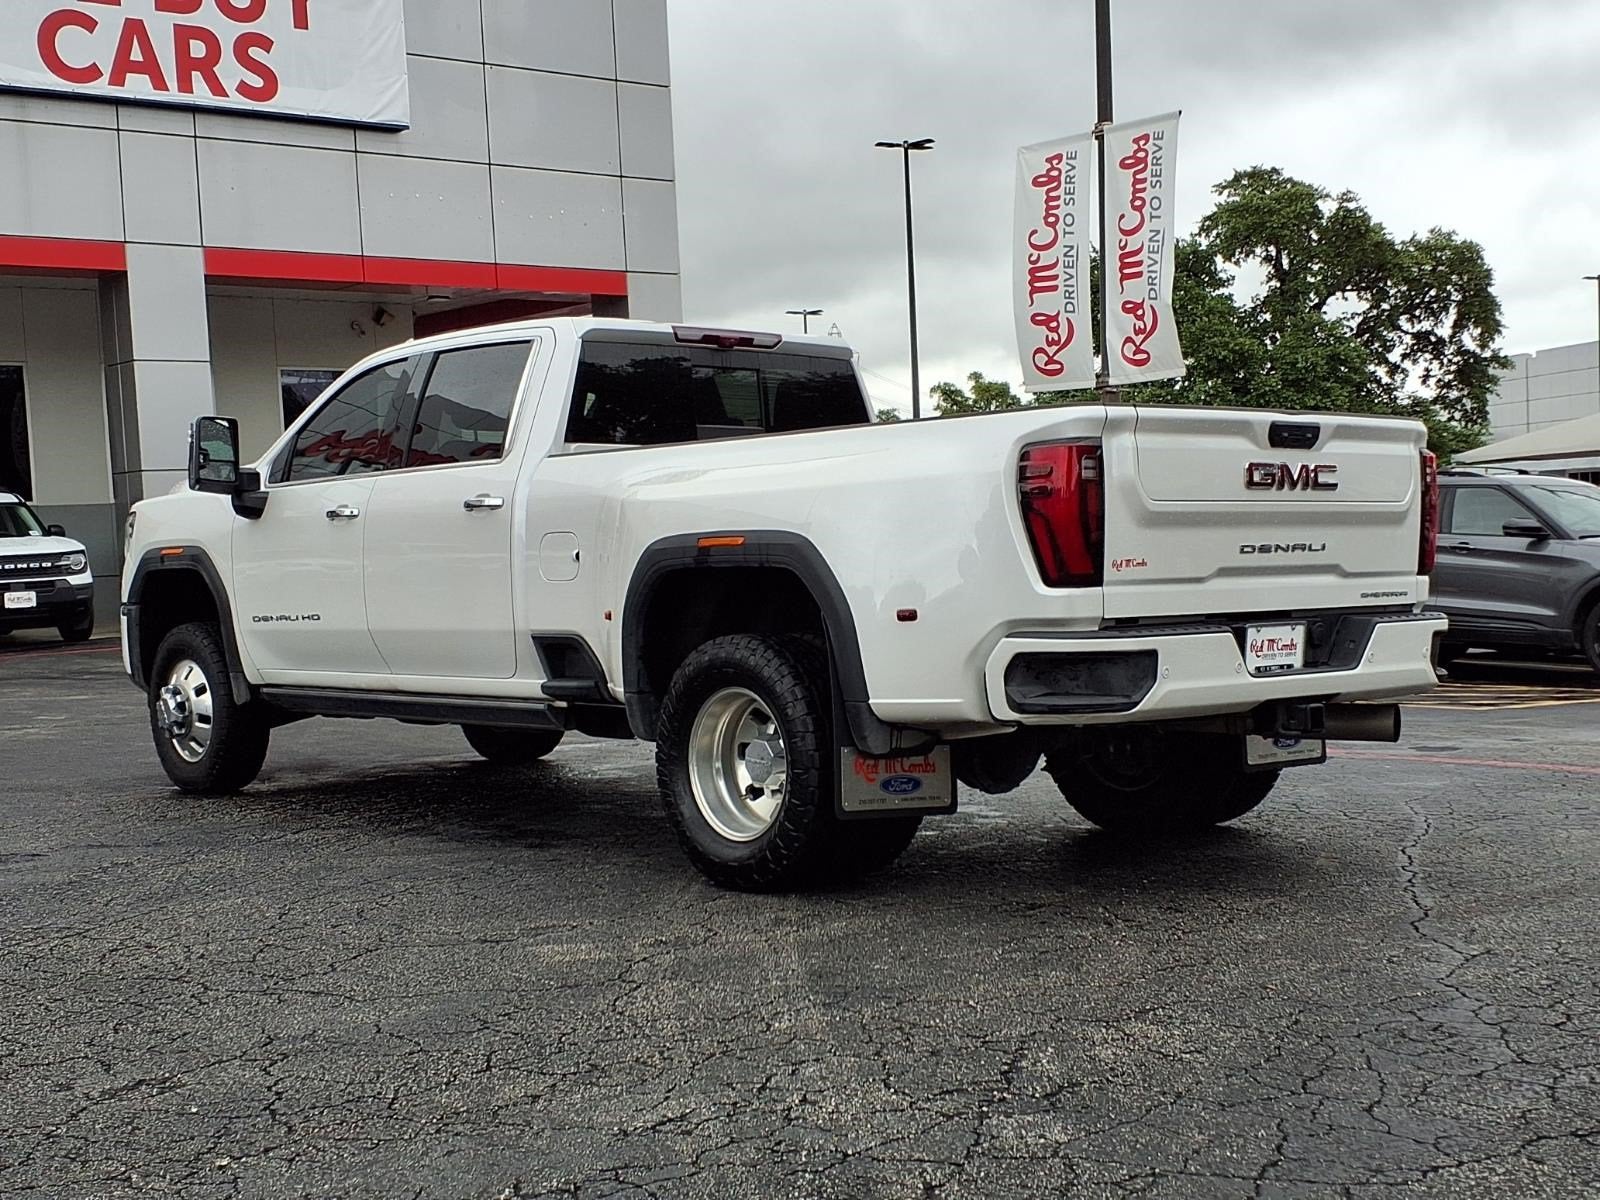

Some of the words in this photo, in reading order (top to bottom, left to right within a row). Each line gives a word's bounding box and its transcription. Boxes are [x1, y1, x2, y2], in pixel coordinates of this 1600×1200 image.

[37, 8, 279, 103] CARS
[1064, 150, 1078, 206] SERVE
[1150, 130, 1165, 188] SERVE
[1063, 212, 1076, 239] TO
[1149, 198, 1162, 223] TO
[1063, 244, 1076, 314] DRIVEN
[1147, 235, 1161, 301] DRIVEN
[1030, 310, 1075, 377] Red
[1120, 298, 1158, 368] Red
[1244, 461, 1339, 491] GMC
[1239, 542, 1326, 554] DENALI
[252, 614, 299, 623] DENALI
[888, 778, 913, 791] Ford
